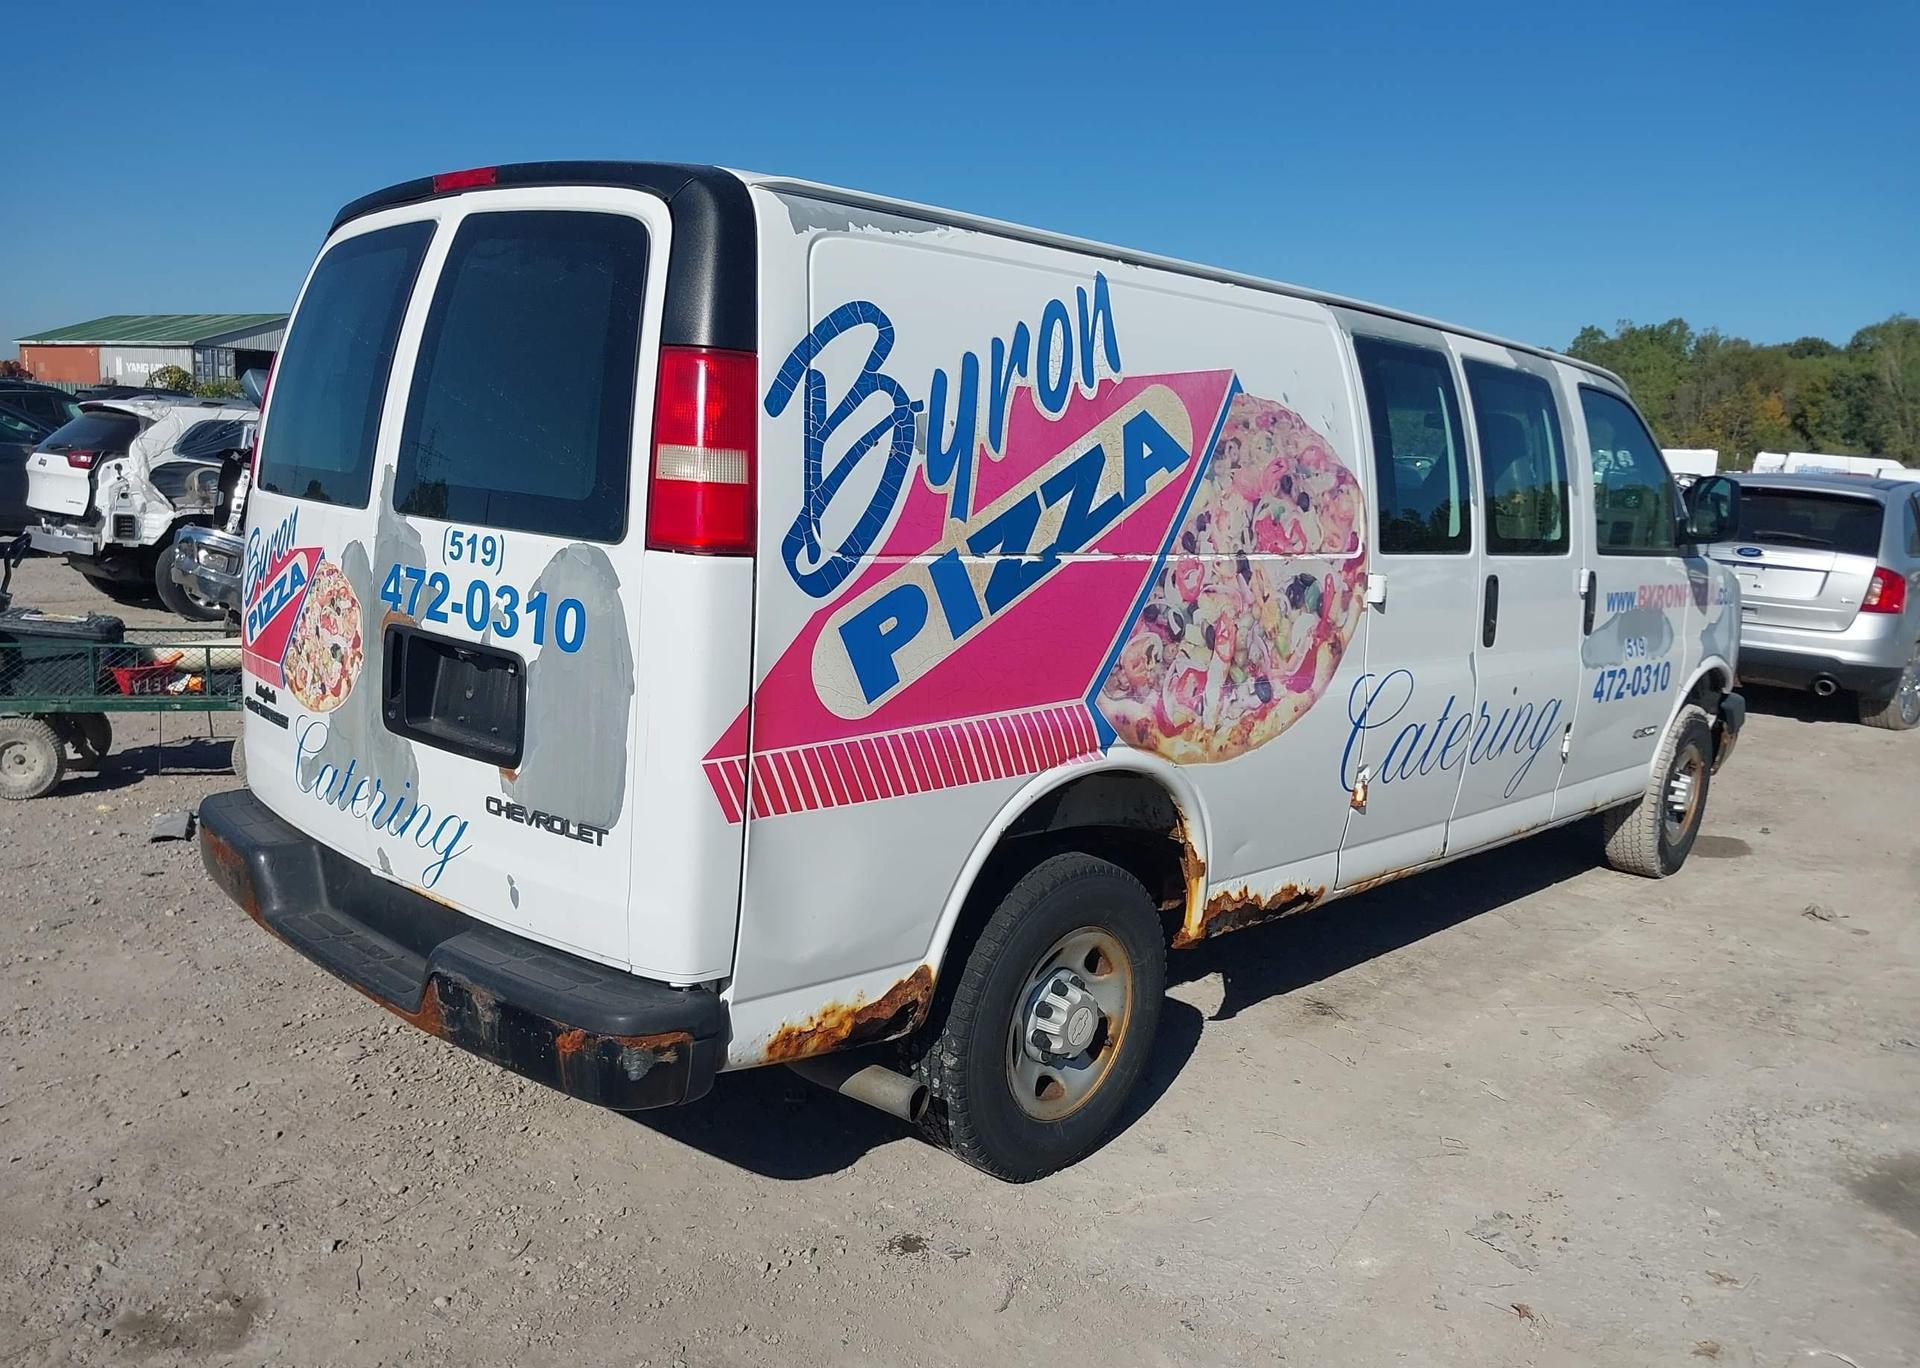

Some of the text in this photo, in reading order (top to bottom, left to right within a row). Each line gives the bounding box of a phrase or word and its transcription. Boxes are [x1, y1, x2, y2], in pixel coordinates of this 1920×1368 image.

[764, 271, 1121, 598] Byron
[243, 505, 298, 608] Byron
[443, 525, 504, 576] (519)
[838, 409, 1190, 704] PIZZA
[248, 562, 306, 642] PIZZA
[381, 564, 586, 653] 472-0310
[1593, 661, 1670, 703] 472-0310
[1341, 669, 1562, 799] Catering
[295, 715, 473, 889] Catering
[486, 796, 609, 847] CHEVROLET
